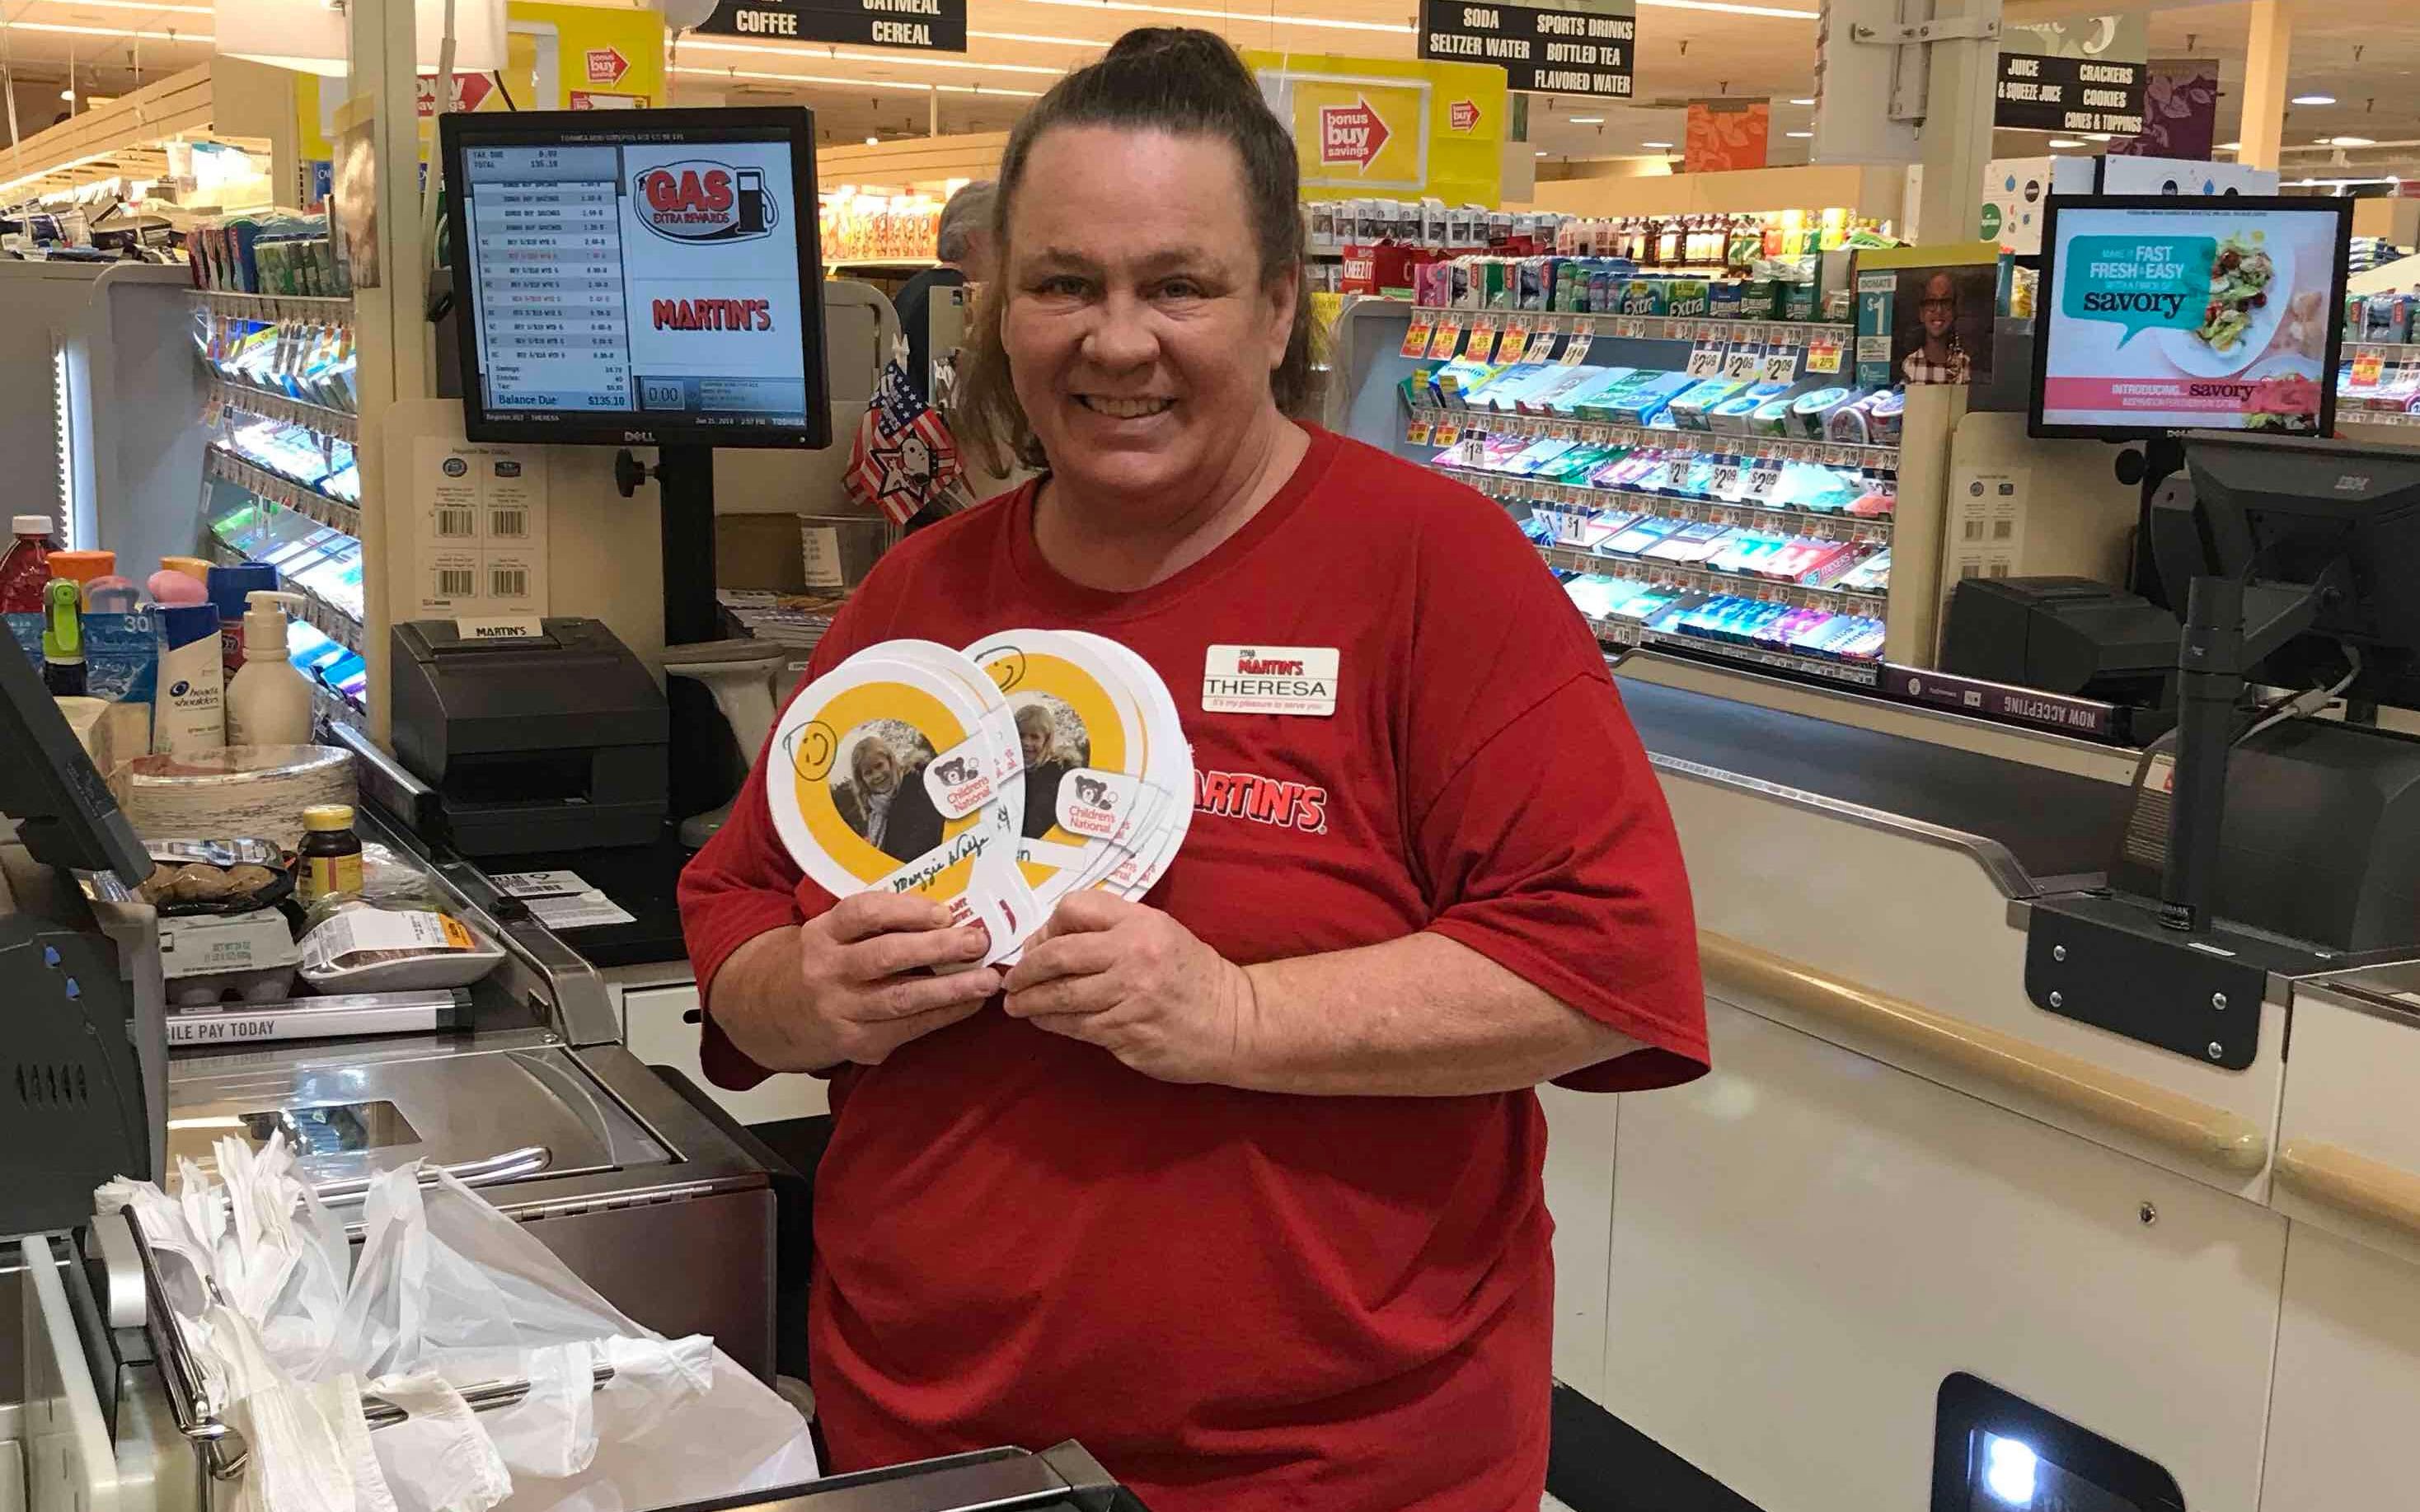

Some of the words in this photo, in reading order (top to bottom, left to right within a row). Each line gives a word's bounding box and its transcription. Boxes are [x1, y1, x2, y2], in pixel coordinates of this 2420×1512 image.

[737, 10, 798, 35] COFFEE
[1463, 7, 1500, 30] SODA
[1537, 14, 1585, 36] SPORTS
[1588, 18, 1633, 40] DRINKS
[871, 21, 933, 45] CEREAL
[1430, 33, 1483, 56] SELTZER
[1486, 38, 1530, 59] WATER
[1546, 43, 1597, 64] BOTTLED
[1600, 47, 1620, 66] TEA
[590, 60, 617, 73] buy
[2008, 59, 2039, 77] JUICE
[2080, 64, 2133, 85] CRACKERS
[1535, 69, 1590, 91] FLAVORED
[1593, 74, 1631, 94] WATER
[1998, 82, 2005, 98] &
[2006, 83, 2038, 102] SQUEEZE
[2039, 86, 2061, 103] JUICE
[2083, 89, 2127, 108] COOKIES
[1326, 112, 1368, 126] bonus
[2064, 112, 2092, 130] CONES
[2094, 114, 2101, 130] &
[2103, 115, 2143, 133] TOPPINGS
[1327, 124, 1370, 147] buy
[1327, 147, 1369, 157] savings
[645, 170, 734, 212] GAS
[653, 212, 684, 224] EXTRA
[685, 213, 730, 224] REWARDS
[2136, 246, 2174, 262] FAST
[2090, 263, 2138, 279] FRESH
[2146, 263, 2184, 279] EASY
[652, 299, 772, 331] MARTIN'S
[1866, 295, 1886, 335] $1
[2083, 292, 2187, 320] savory
[498, 395, 536, 405] Balance
[588, 396, 626, 406] $135.10
[649, 387, 678, 403] 0.00
[2189, 383, 2255, 402] savory
[624, 431, 655, 442] DELL
[1567, 518, 1579, 538] $1
[124, 616, 150, 633] 30
[476, 625, 528, 637] MARTIN'S
[1238, 658, 1305, 676] MARTIN'S
[1205, 679, 1327, 697] THERESA
[2004, 695, 2067, 723] ACCEPTING
[2068, 709, 2096, 728] NOW
[1194, 770, 1326, 832] RTIN'S
[1070, 816, 1112, 834] National
[168, 1024, 194, 1042] ILE
[199, 1022, 225, 1040] PAY
[230, 1020, 274, 1037] TODAY
